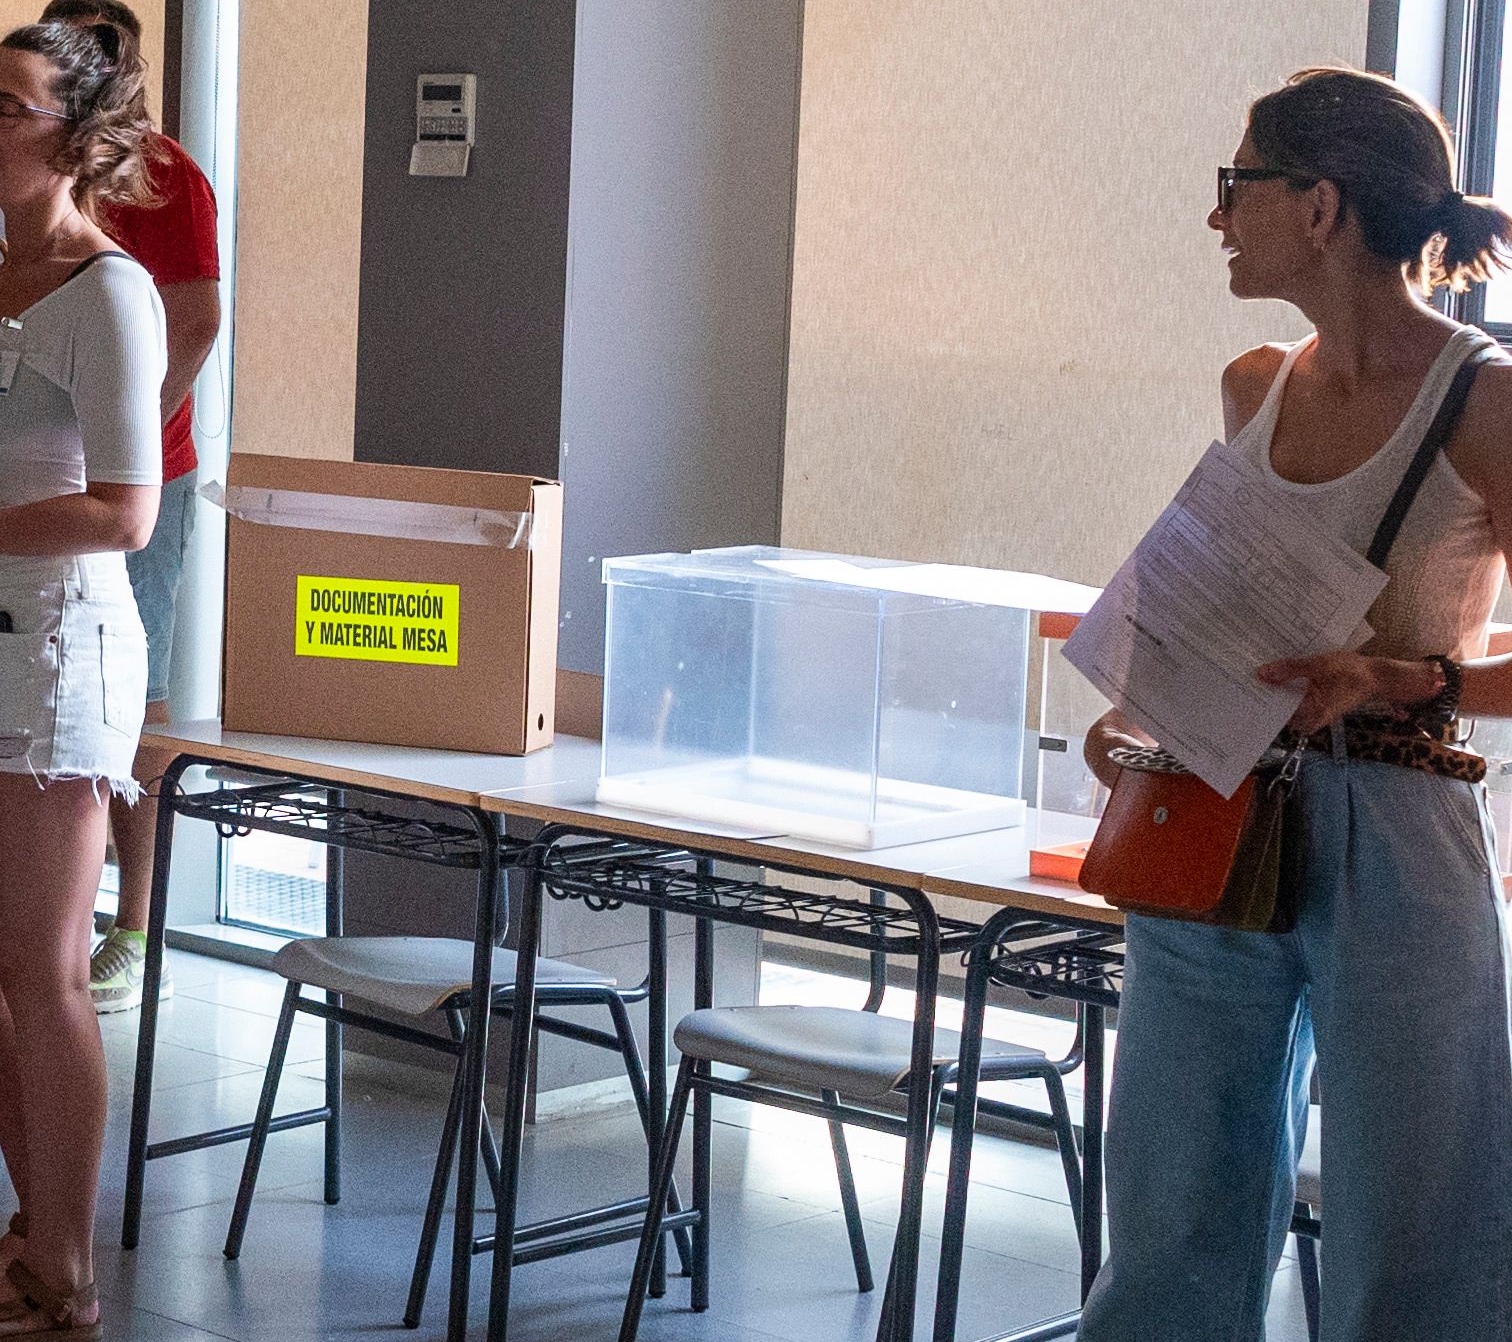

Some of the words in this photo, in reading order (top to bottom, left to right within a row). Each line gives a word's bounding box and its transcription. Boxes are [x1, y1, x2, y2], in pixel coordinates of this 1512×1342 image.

[310, 588, 444, 620] DOCUMENTACIÓN
[305, 620, 315, 644] Y
[320, 621, 397, 650] MATERIAL
[402, 627, 448, 653] MESA
